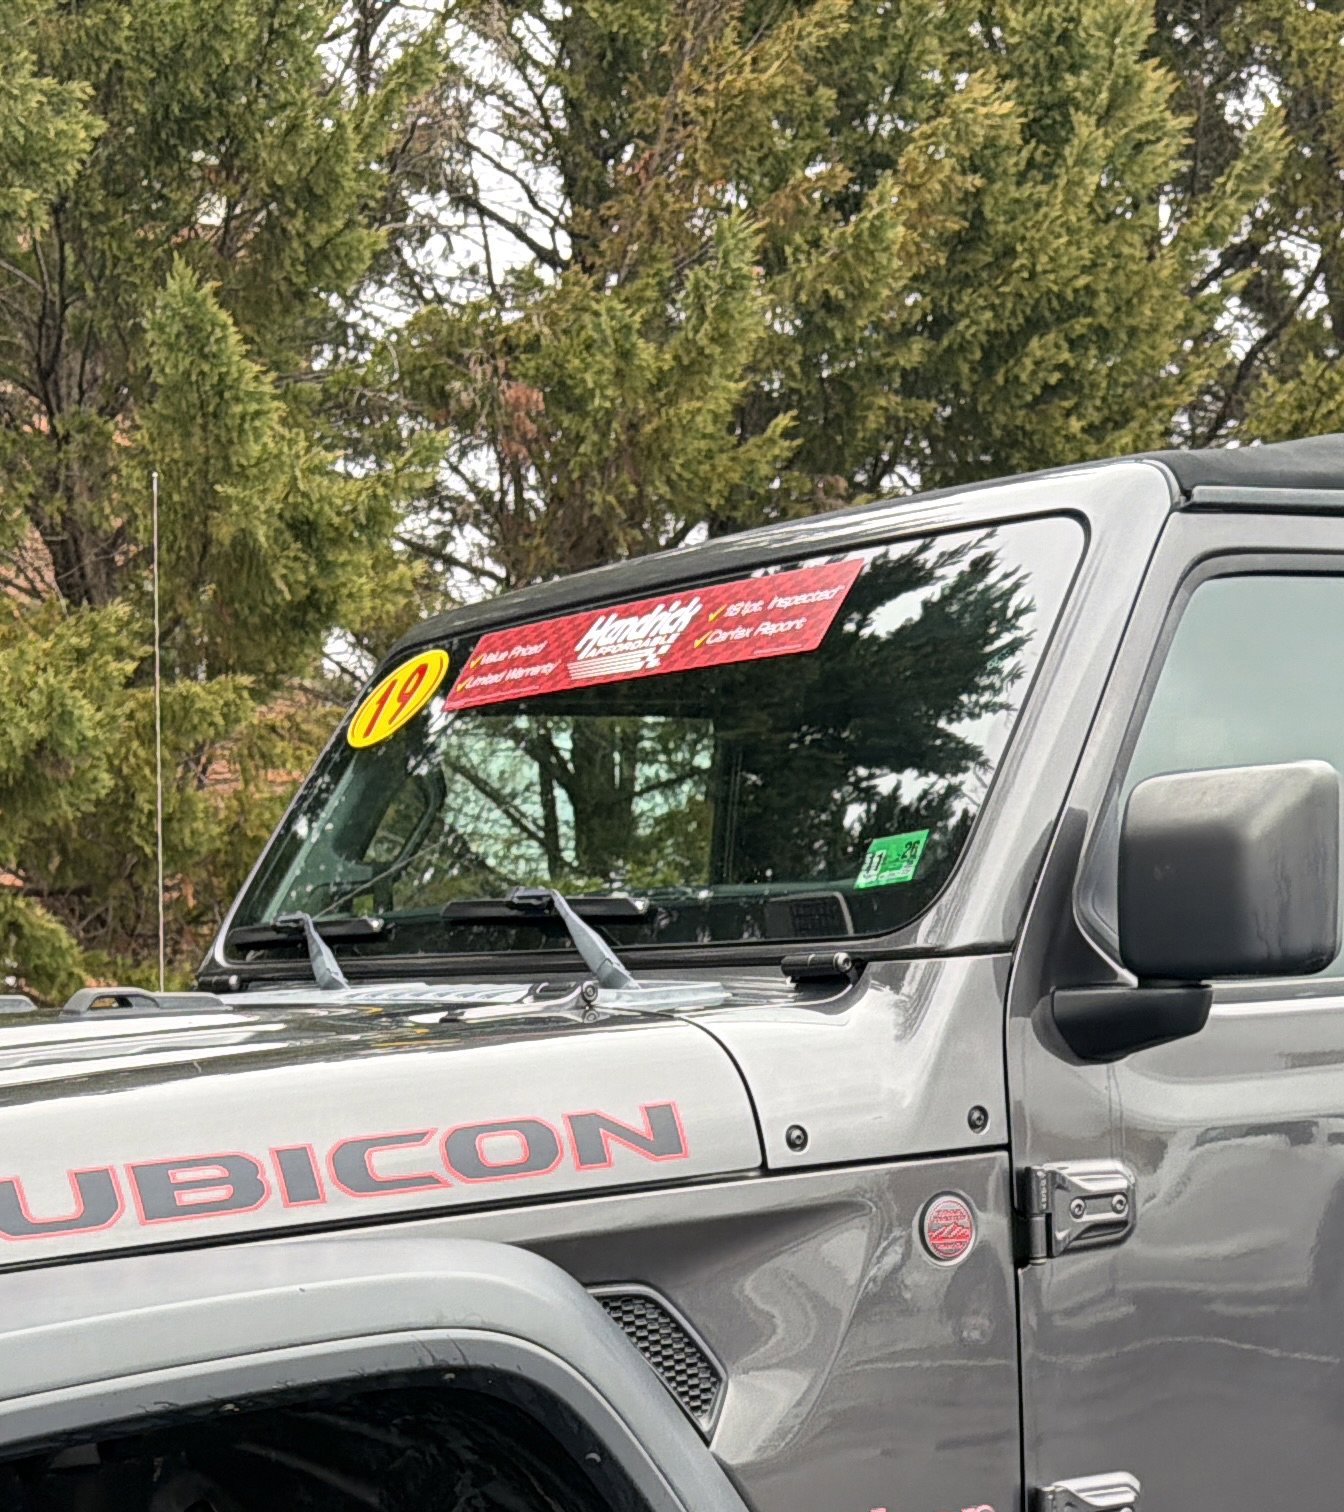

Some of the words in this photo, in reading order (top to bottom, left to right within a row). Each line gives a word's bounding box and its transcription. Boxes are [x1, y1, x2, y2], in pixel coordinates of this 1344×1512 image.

[575, 597, 702, 660] Hendrick
[753, 617, 806, 639] Report
[364, 662, 429, 739] 19
